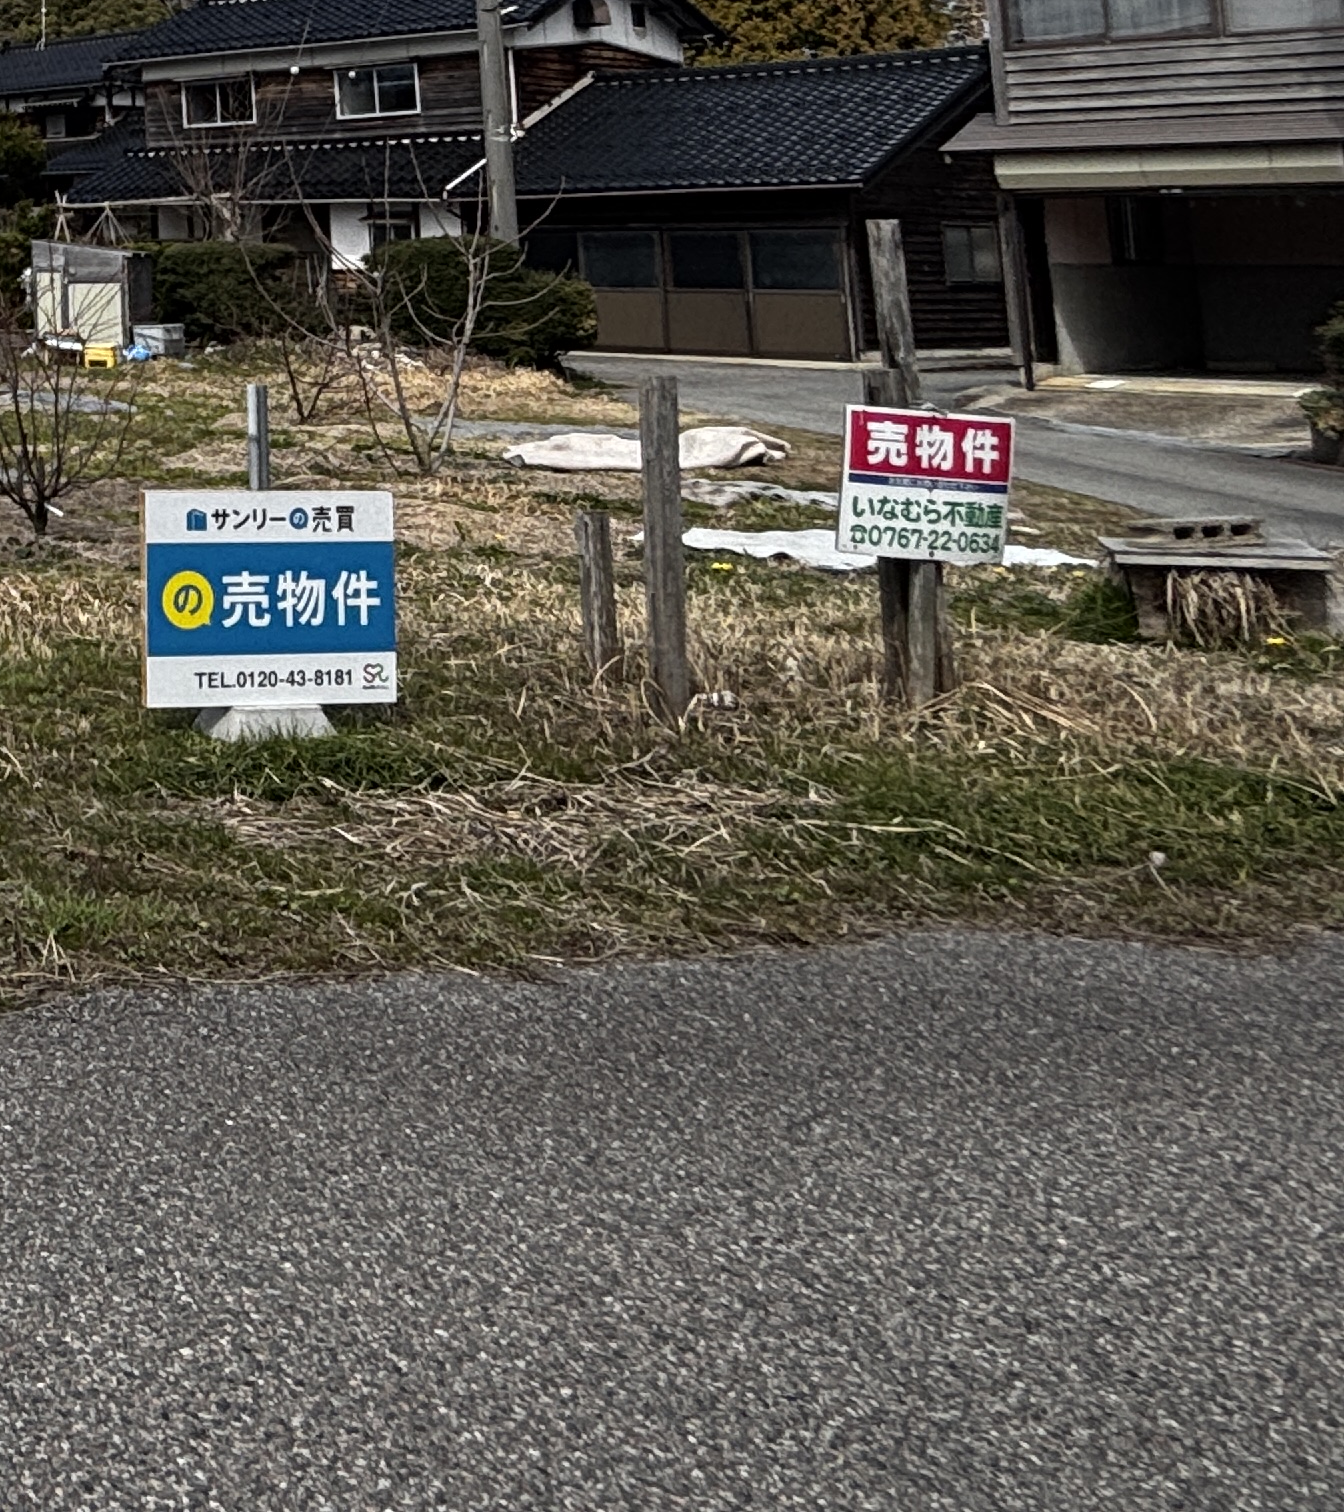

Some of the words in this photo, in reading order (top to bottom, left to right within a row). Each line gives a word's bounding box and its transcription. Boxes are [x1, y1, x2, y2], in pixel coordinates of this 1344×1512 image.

[866, 421, 999, 474] 売物件
[211, 505, 355, 532] サンリーの売買
[852, 495, 1004, 528] いなむら不動産
[868, 524, 1000, 554] 0767-22-0634
[193, 668, 353, 689] TEL.0120-43-8181
